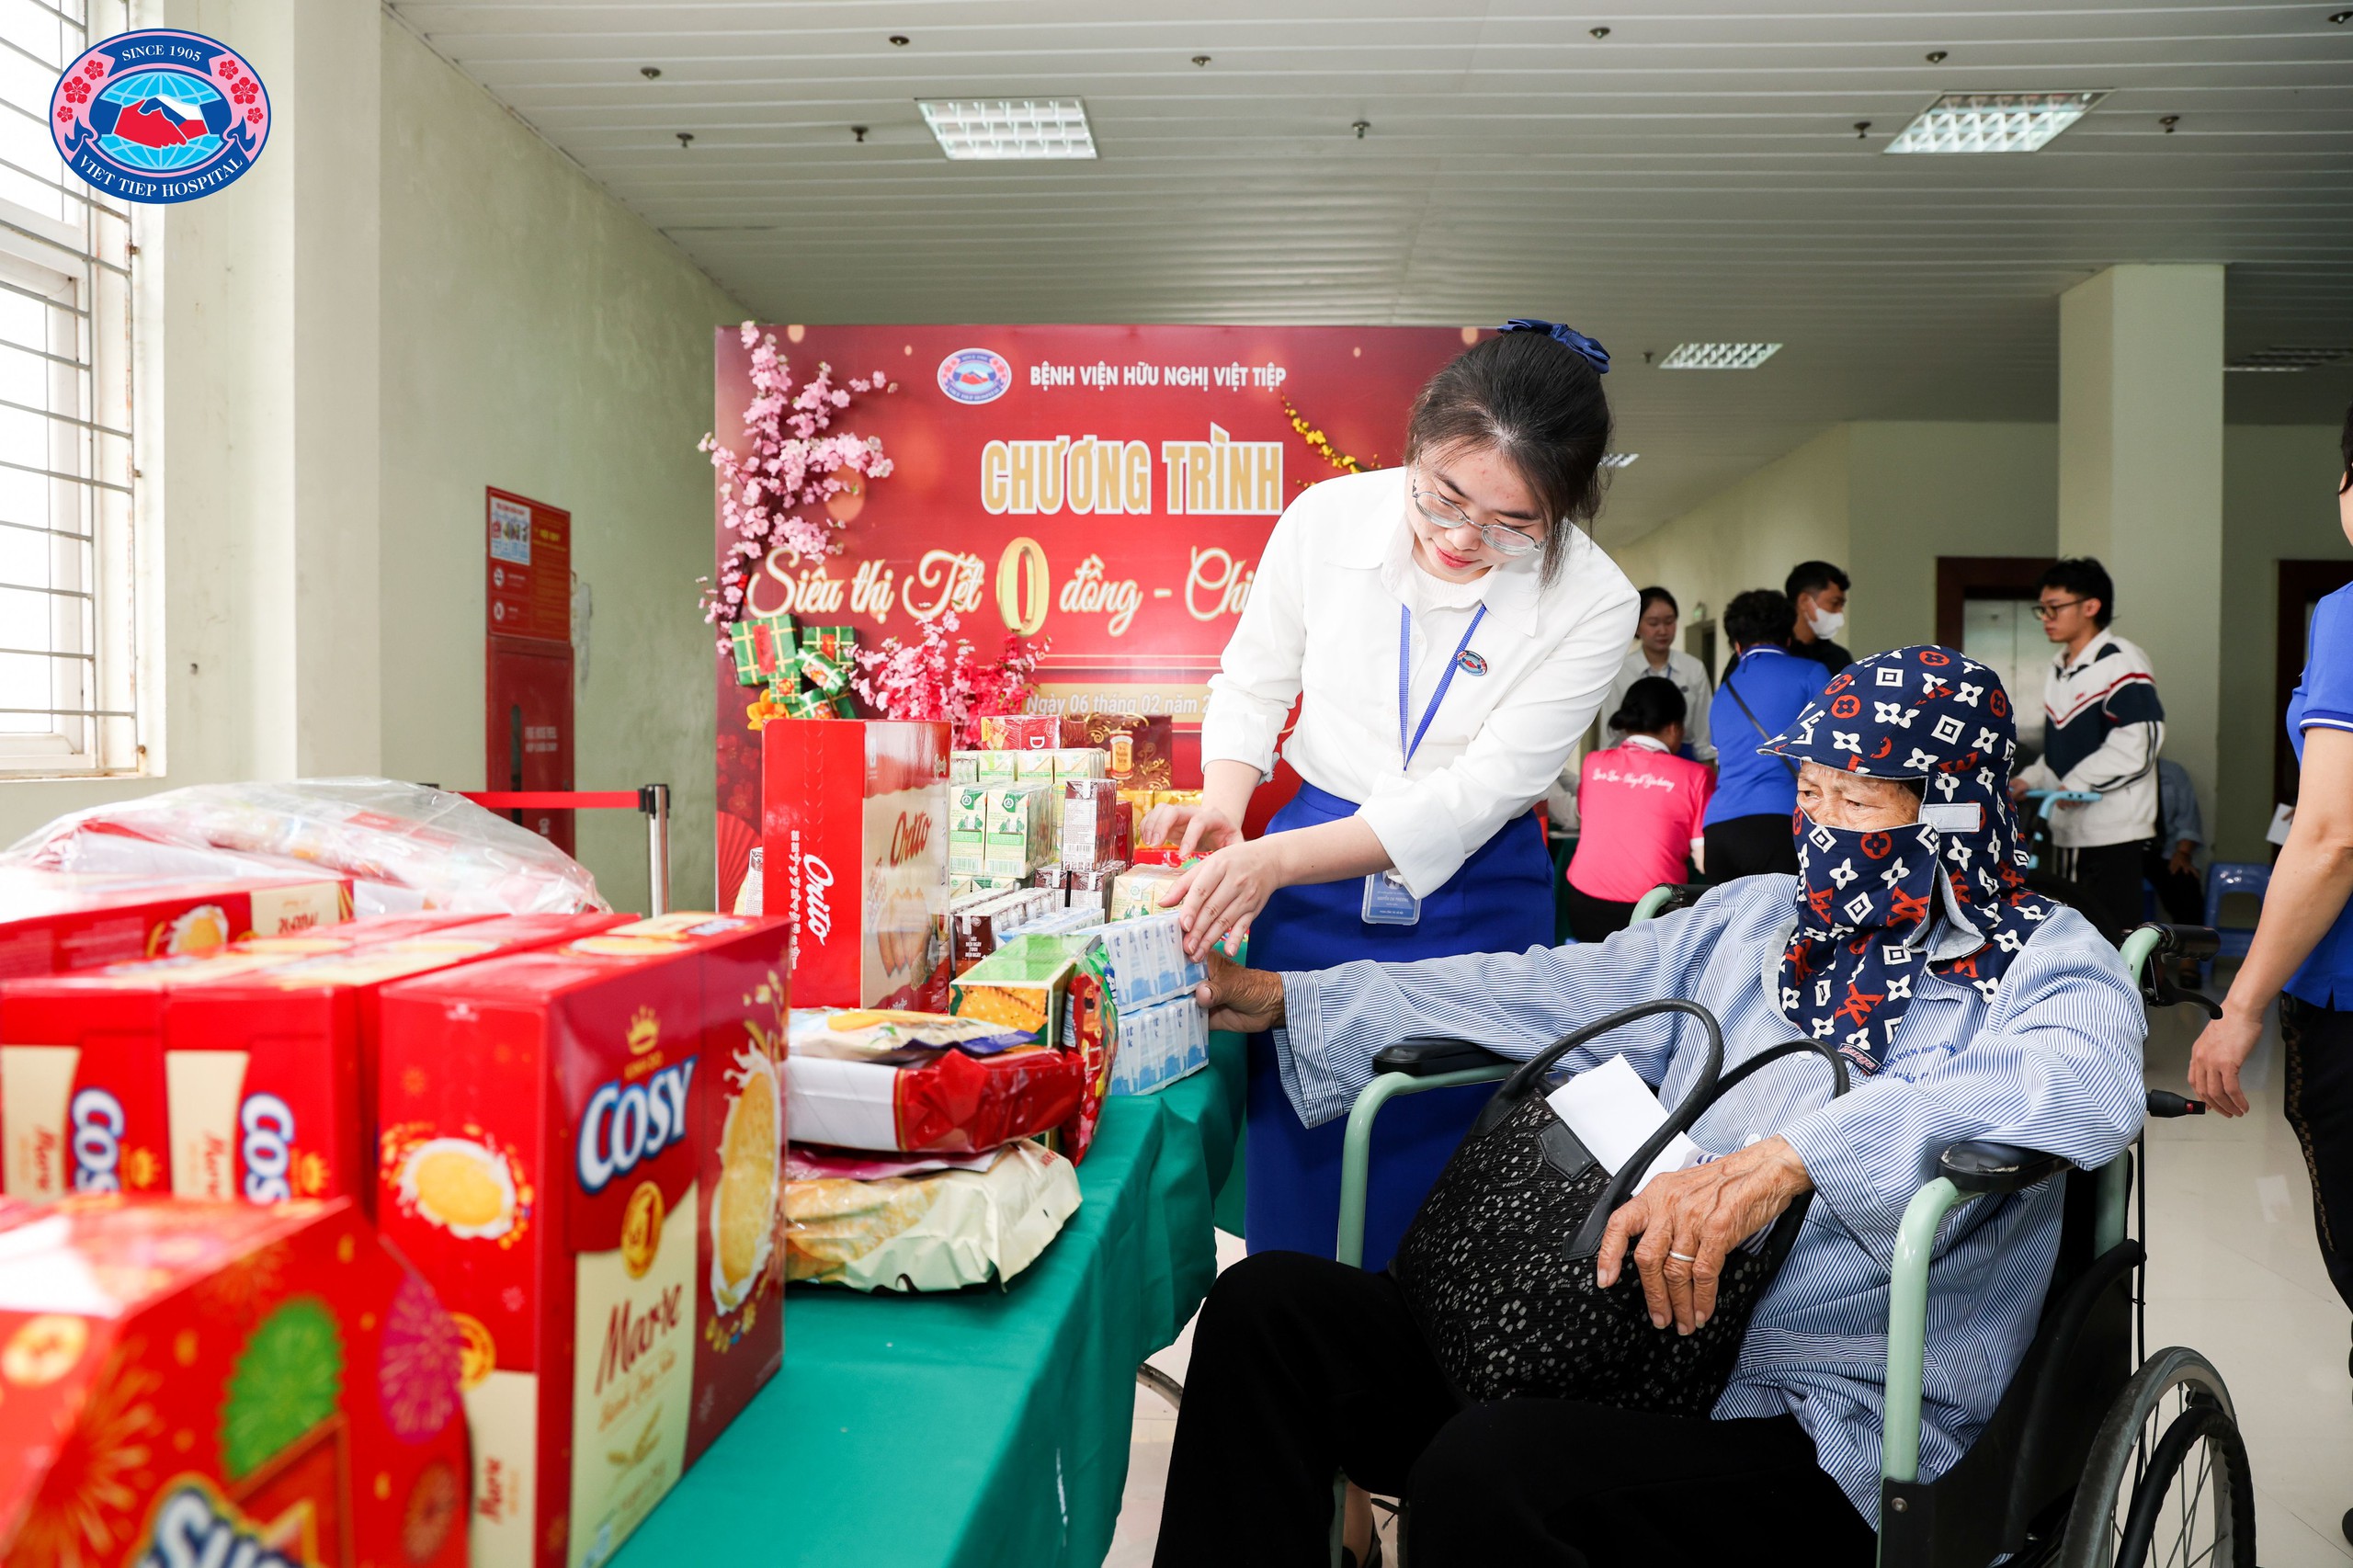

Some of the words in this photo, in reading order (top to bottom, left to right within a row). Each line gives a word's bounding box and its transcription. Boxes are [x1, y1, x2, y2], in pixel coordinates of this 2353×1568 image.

[1030, 360, 1074, 392] BỆNH
[1080, 360, 1119, 392] VIỆN
[1123, 361, 1159, 386] HỮU
[1164, 365, 1209, 392] NGHỊ
[1213, 361, 1248, 392] VIỆT
[1252, 361, 1287, 392] TIỆP
[982, 435, 1152, 515] CHƯƠNG
[1162, 422, 1284, 516] TRÌNH
[746, 546, 846, 619] Siêu
[850, 559, 895, 624] thị
[902, 549, 986, 619] Tết
[995, 537, 1051, 637] 0
[1059, 553, 1143, 638] đồng
[1026, 693, 1066, 716] Ngày
[1069, 694, 1089, 713] 06
[1093, 694, 1136, 714] tháng
[1141, 694, 1160, 713] 02
[1165, 694, 1198, 714] năm
[890, 811, 932, 869] Orito
[802, 854, 835, 946] Orito
[72, 1087, 125, 1193] COS
[242, 1092, 294, 1205] COS
[577, 1054, 699, 1195] COSY
